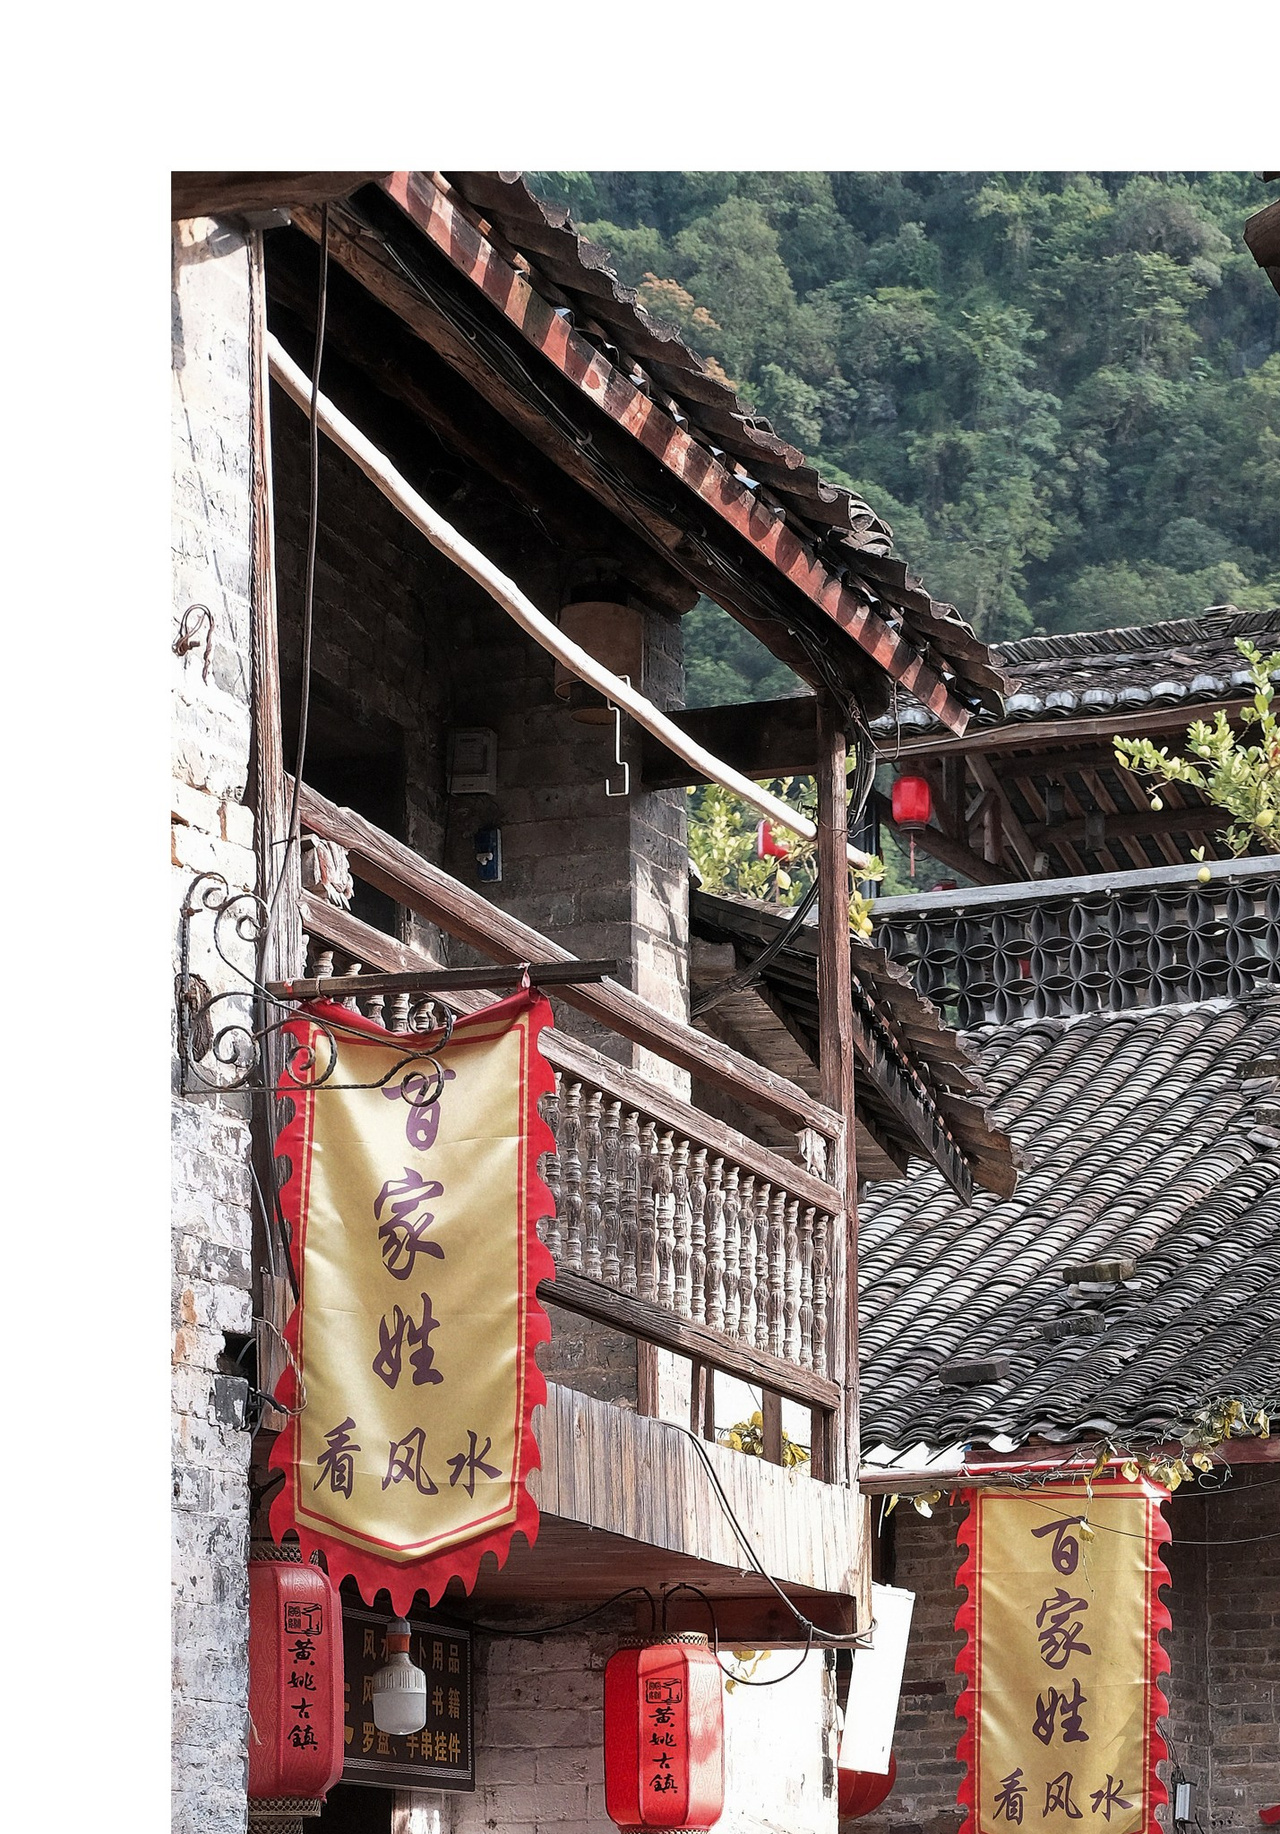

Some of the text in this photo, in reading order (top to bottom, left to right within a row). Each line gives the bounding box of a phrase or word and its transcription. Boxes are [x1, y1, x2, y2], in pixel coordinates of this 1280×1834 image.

[371, 1068, 456, 1391] 百家姓
[313, 1416, 503, 1500] 看风水
[1031, 1515, 1093, 1745] 百家姓
[992, 1767, 1135, 1826] 看风水
